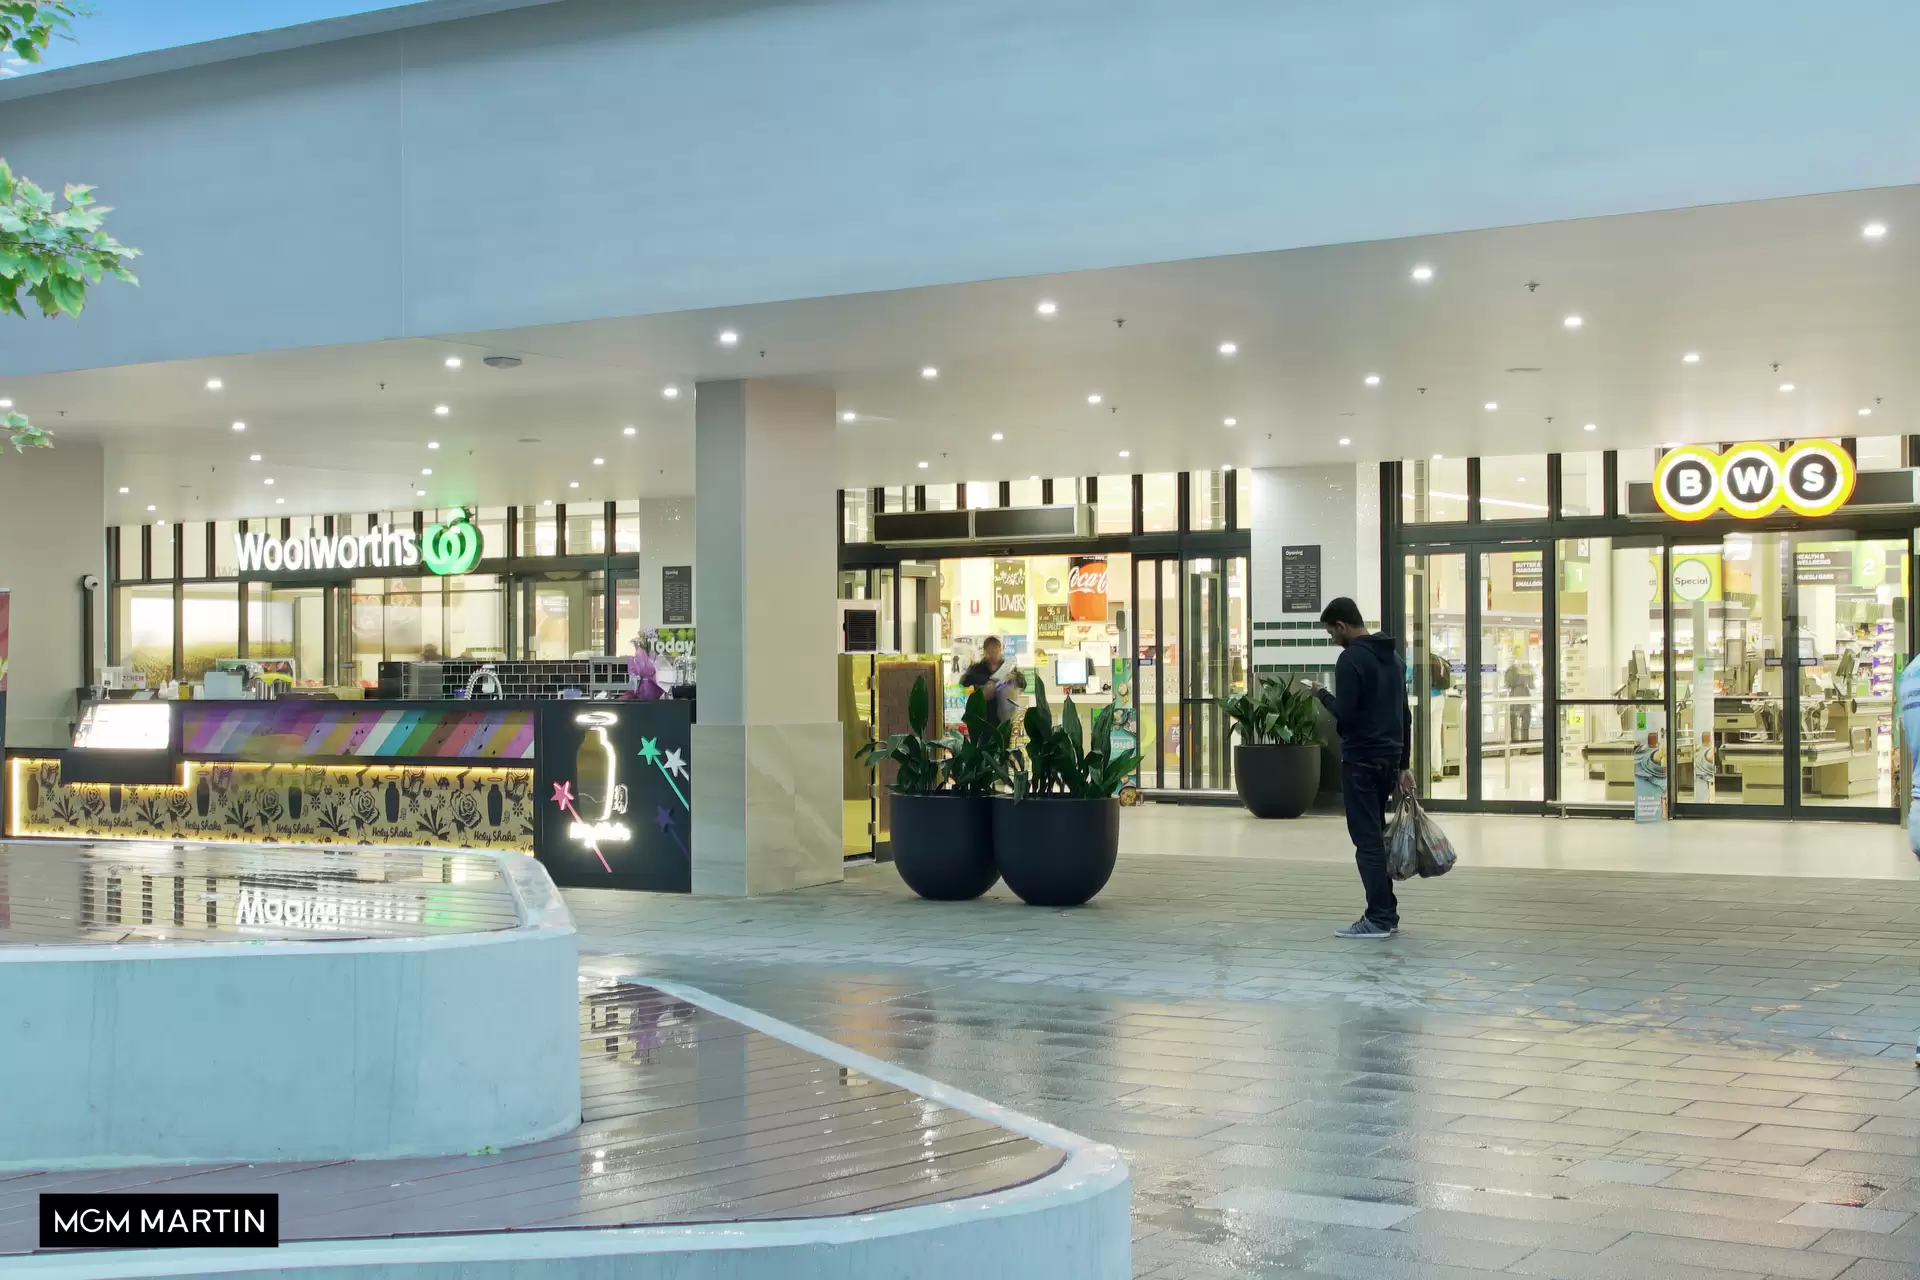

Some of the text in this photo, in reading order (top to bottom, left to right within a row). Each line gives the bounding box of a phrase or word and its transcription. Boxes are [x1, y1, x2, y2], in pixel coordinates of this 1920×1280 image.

[234, 521, 419, 571] Woolworths
[1863, 559, 1875, 575] 2
[1575, 567, 1583, 584] 1
[1675, 577, 1708, 586] Special
[647, 636, 694, 656] Today
[98, 816, 133, 832] Holy Shake
[185, 819, 221, 835] Holy Shake
[276, 823, 315, 839] Holy Shake
[371, 826, 413, 842] Holy Shake
[474, 830, 517, 846] Holy Shake
